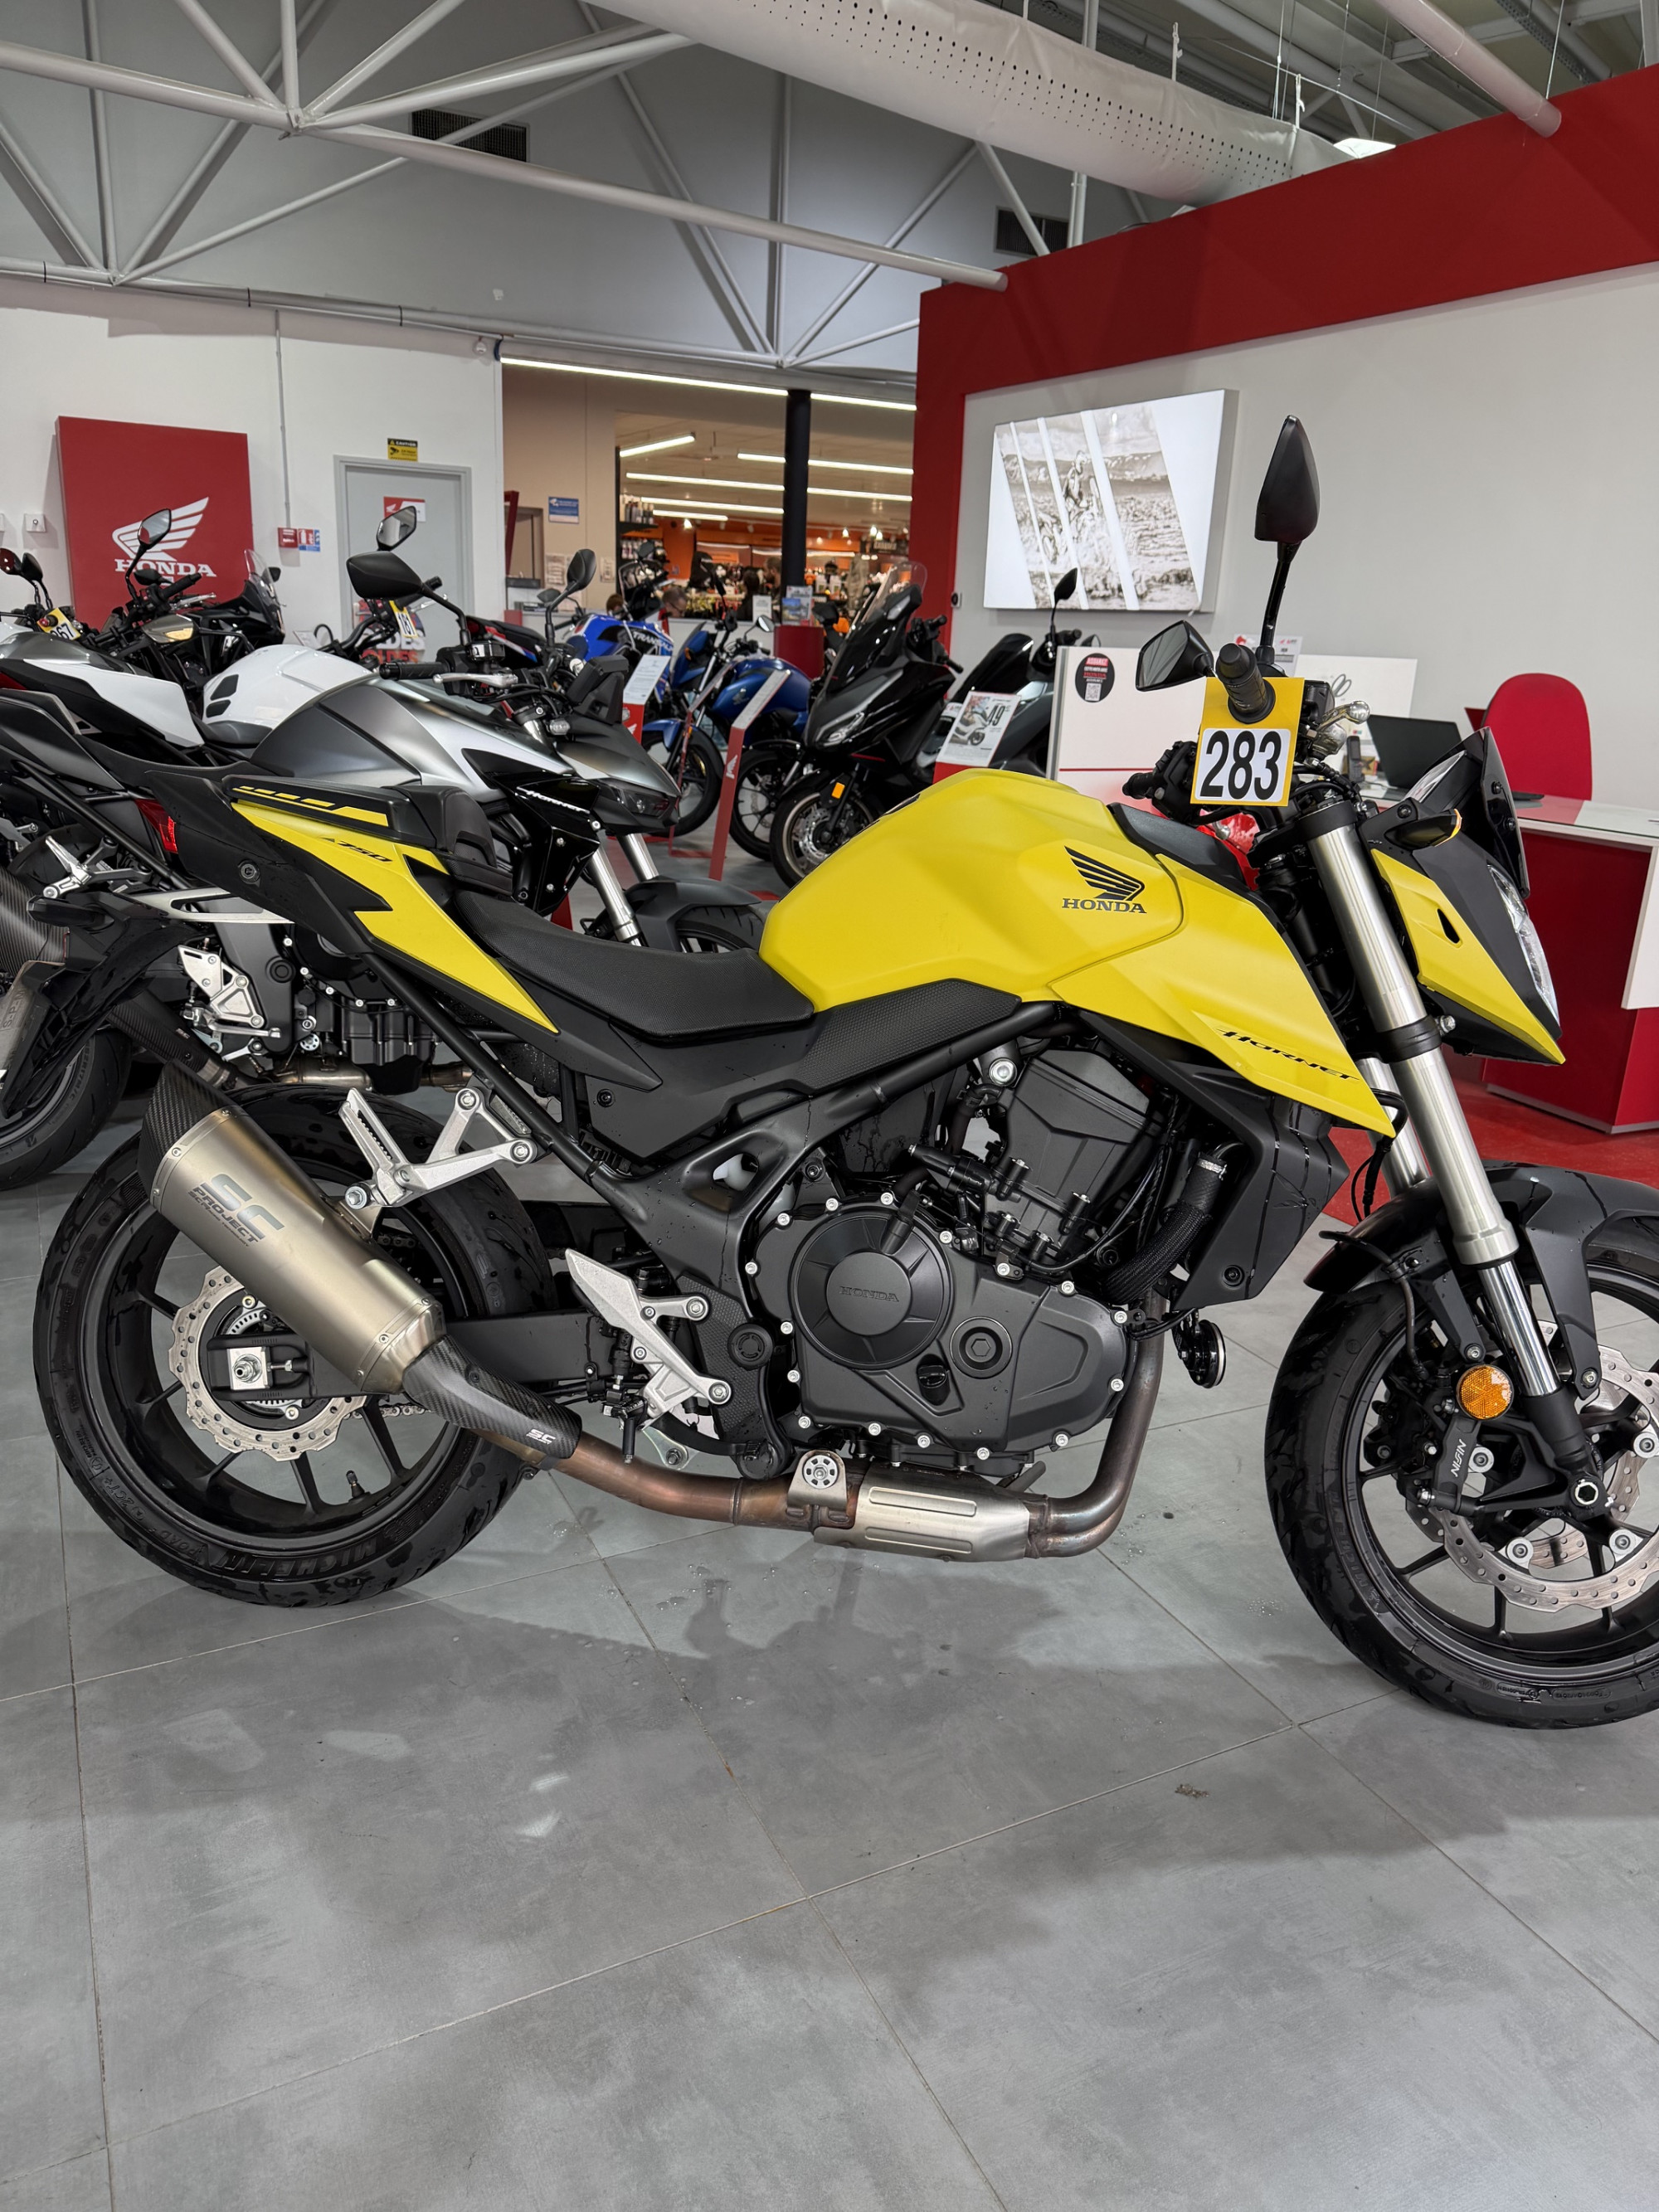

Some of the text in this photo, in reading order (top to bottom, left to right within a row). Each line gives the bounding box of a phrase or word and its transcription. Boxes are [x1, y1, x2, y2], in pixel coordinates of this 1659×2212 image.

[114, 558, 217, 577] HONDA
[1199, 730, 1282, 800] 283
[338, 840, 393, 863] 750
[1062, 897, 1147, 914] HONDA
[192, 1187, 259, 1242] PROJECT
[200, 1174, 285, 1240] SC
[839, 1286, 900, 1302] HONDA
